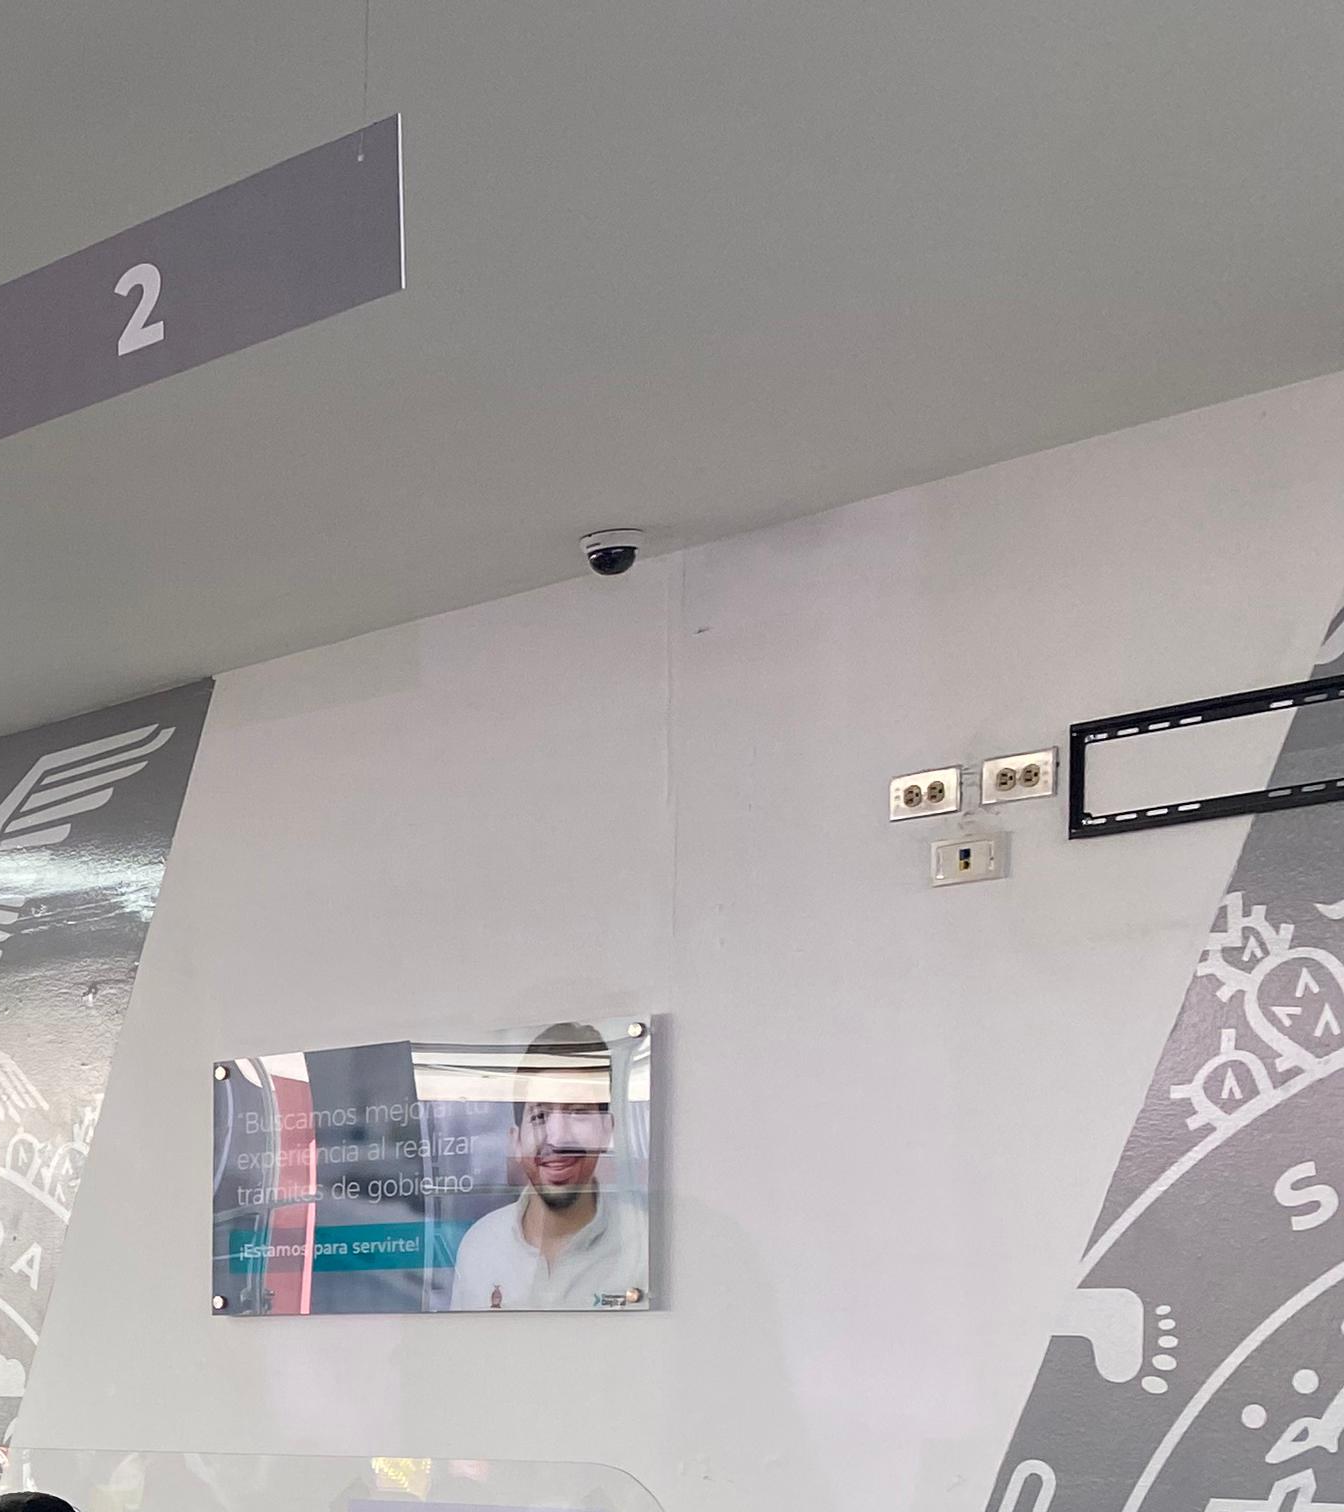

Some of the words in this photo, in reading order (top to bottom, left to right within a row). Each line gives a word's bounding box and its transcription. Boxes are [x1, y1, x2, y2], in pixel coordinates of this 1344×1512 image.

[113, 262, 165, 357] 2
[237, 1140, 358, 1173] experiencia
[368, 1136, 386, 1160] al
[396, 1133, 479, 1160] realizar
[237, 1182, 324, 1206] trámites
[331, 1175, 360, 1200] de
[314, 1242, 348, 1261] para
[352, 1235, 420, 1256] servirte!
